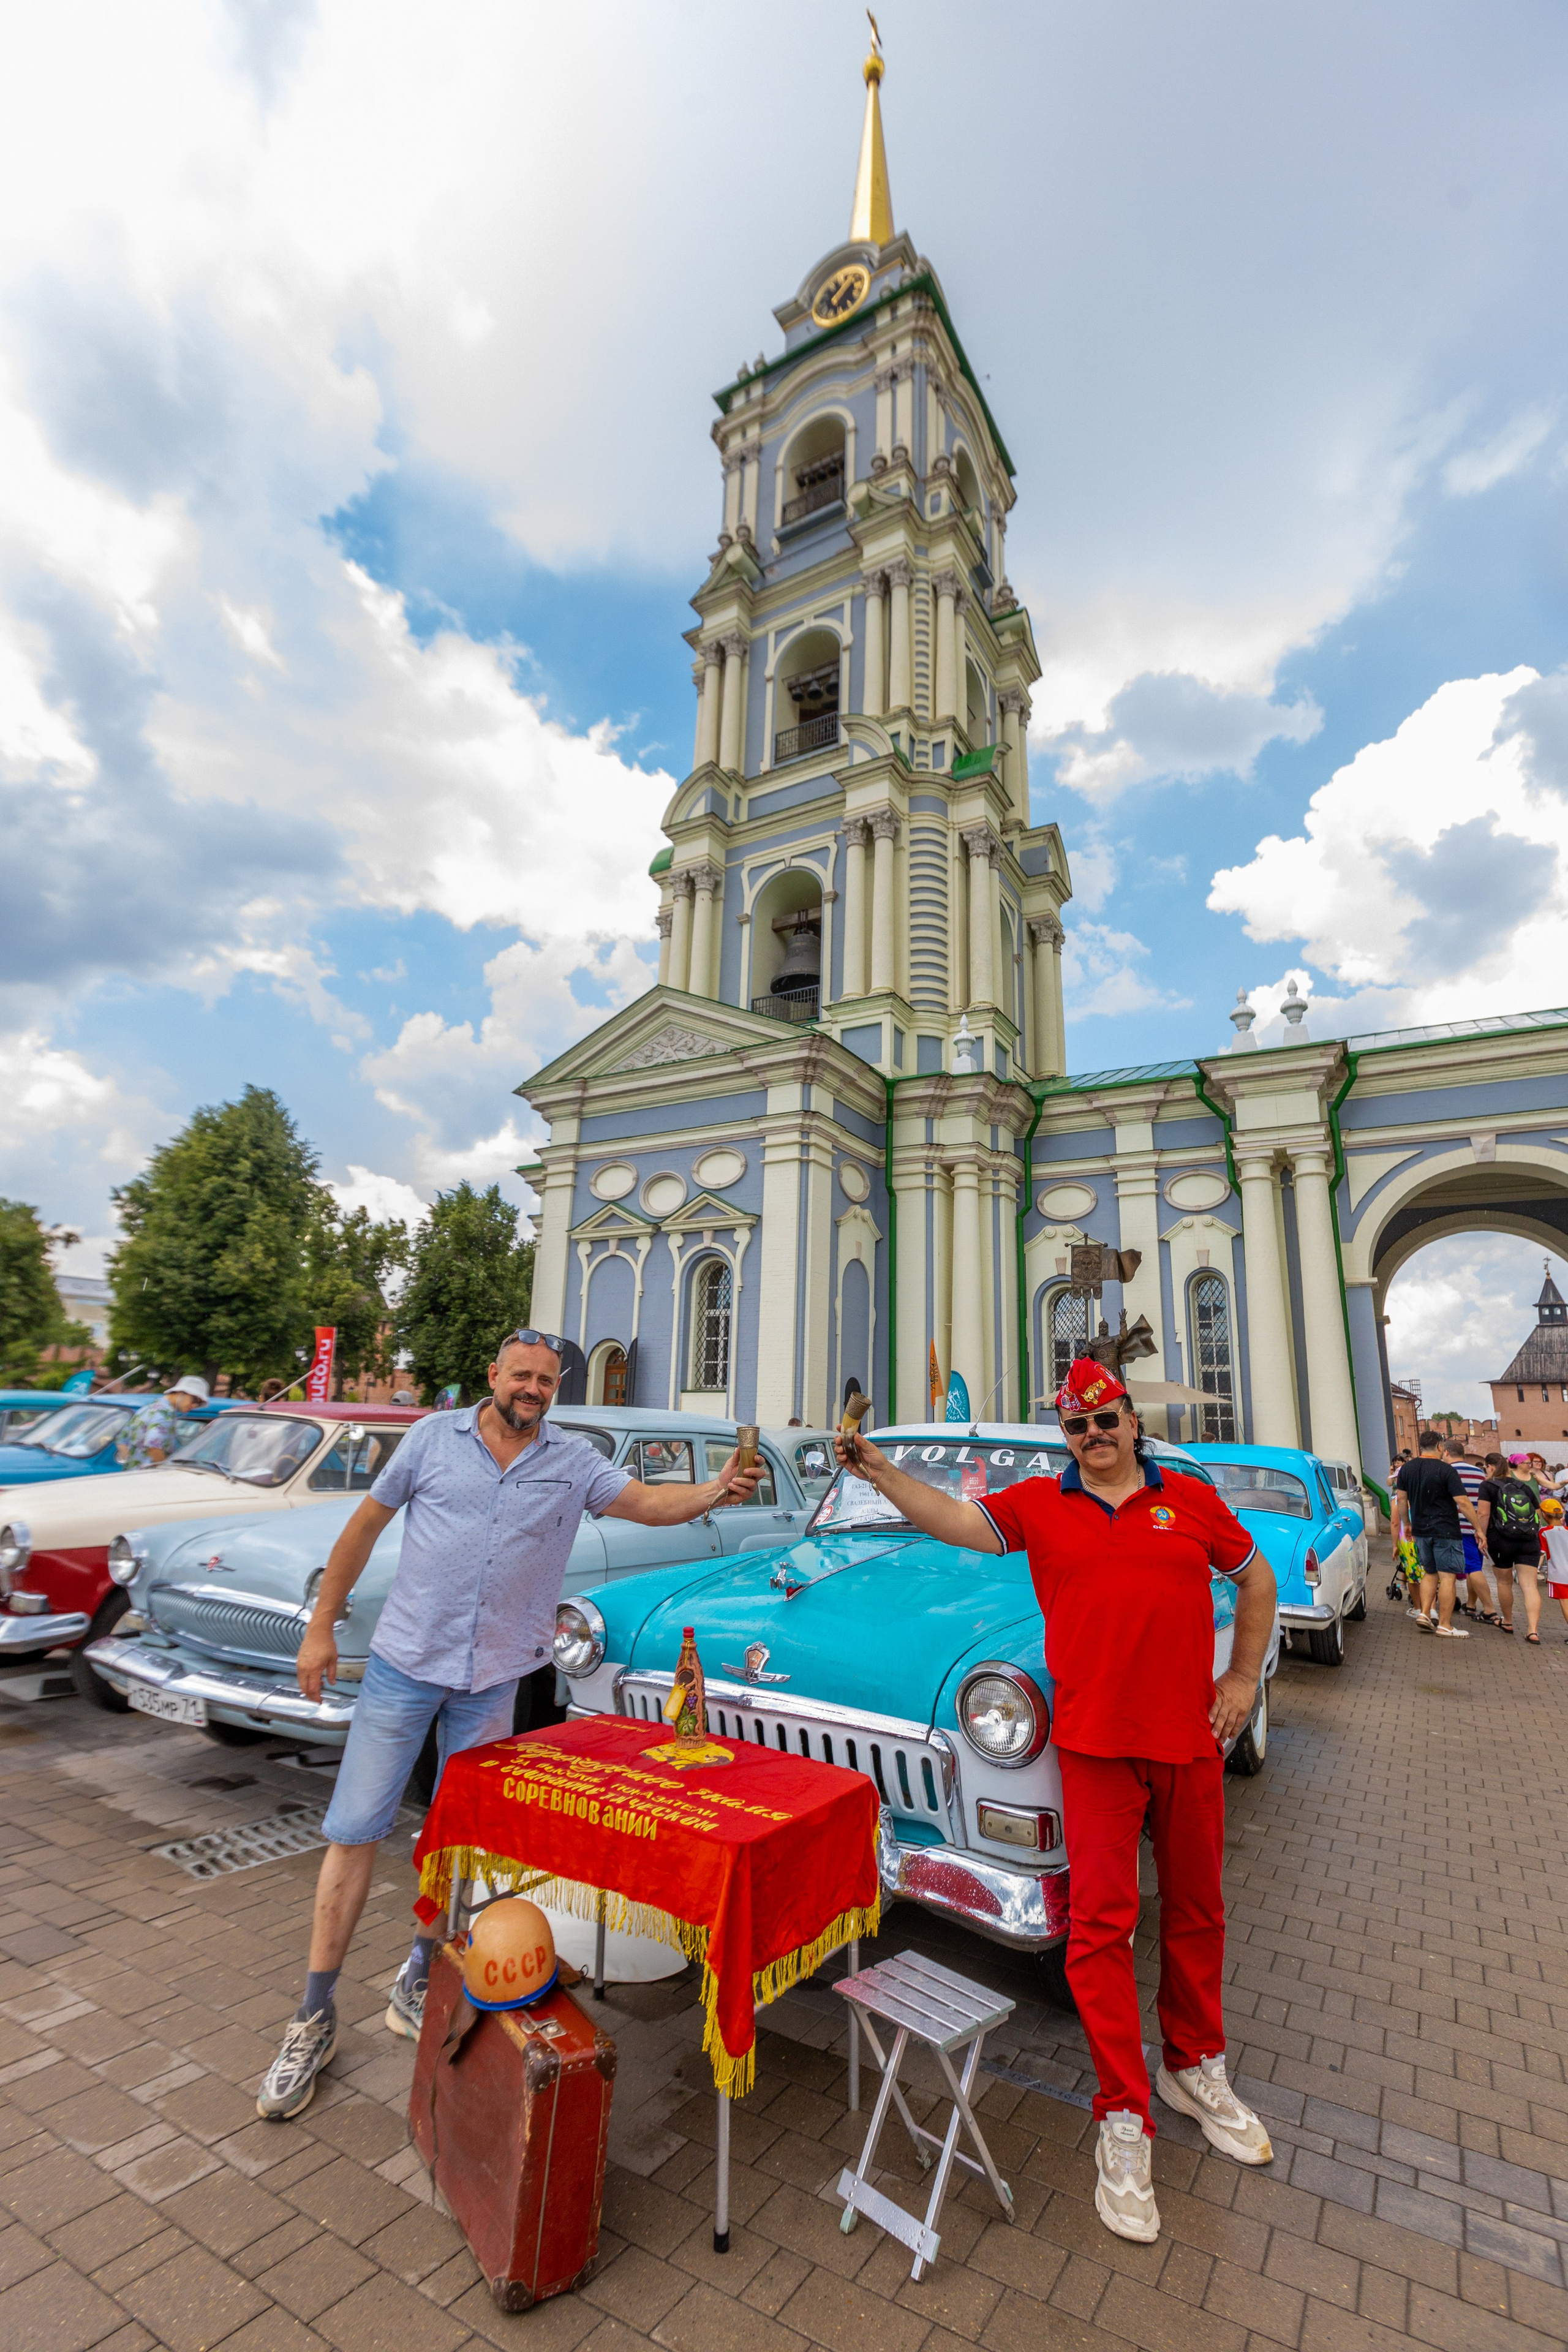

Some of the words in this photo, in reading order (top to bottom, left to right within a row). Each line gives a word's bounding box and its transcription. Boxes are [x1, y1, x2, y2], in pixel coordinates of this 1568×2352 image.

[894, 1445, 1050, 1471] VOLGA
[510, 1757, 530, 1767] ЗА
[611, 1783, 719, 1818] ПОКАЗАТЕЛИ
[687, 1788, 793, 1821] знамя
[484, 1945, 547, 1986] СССР
